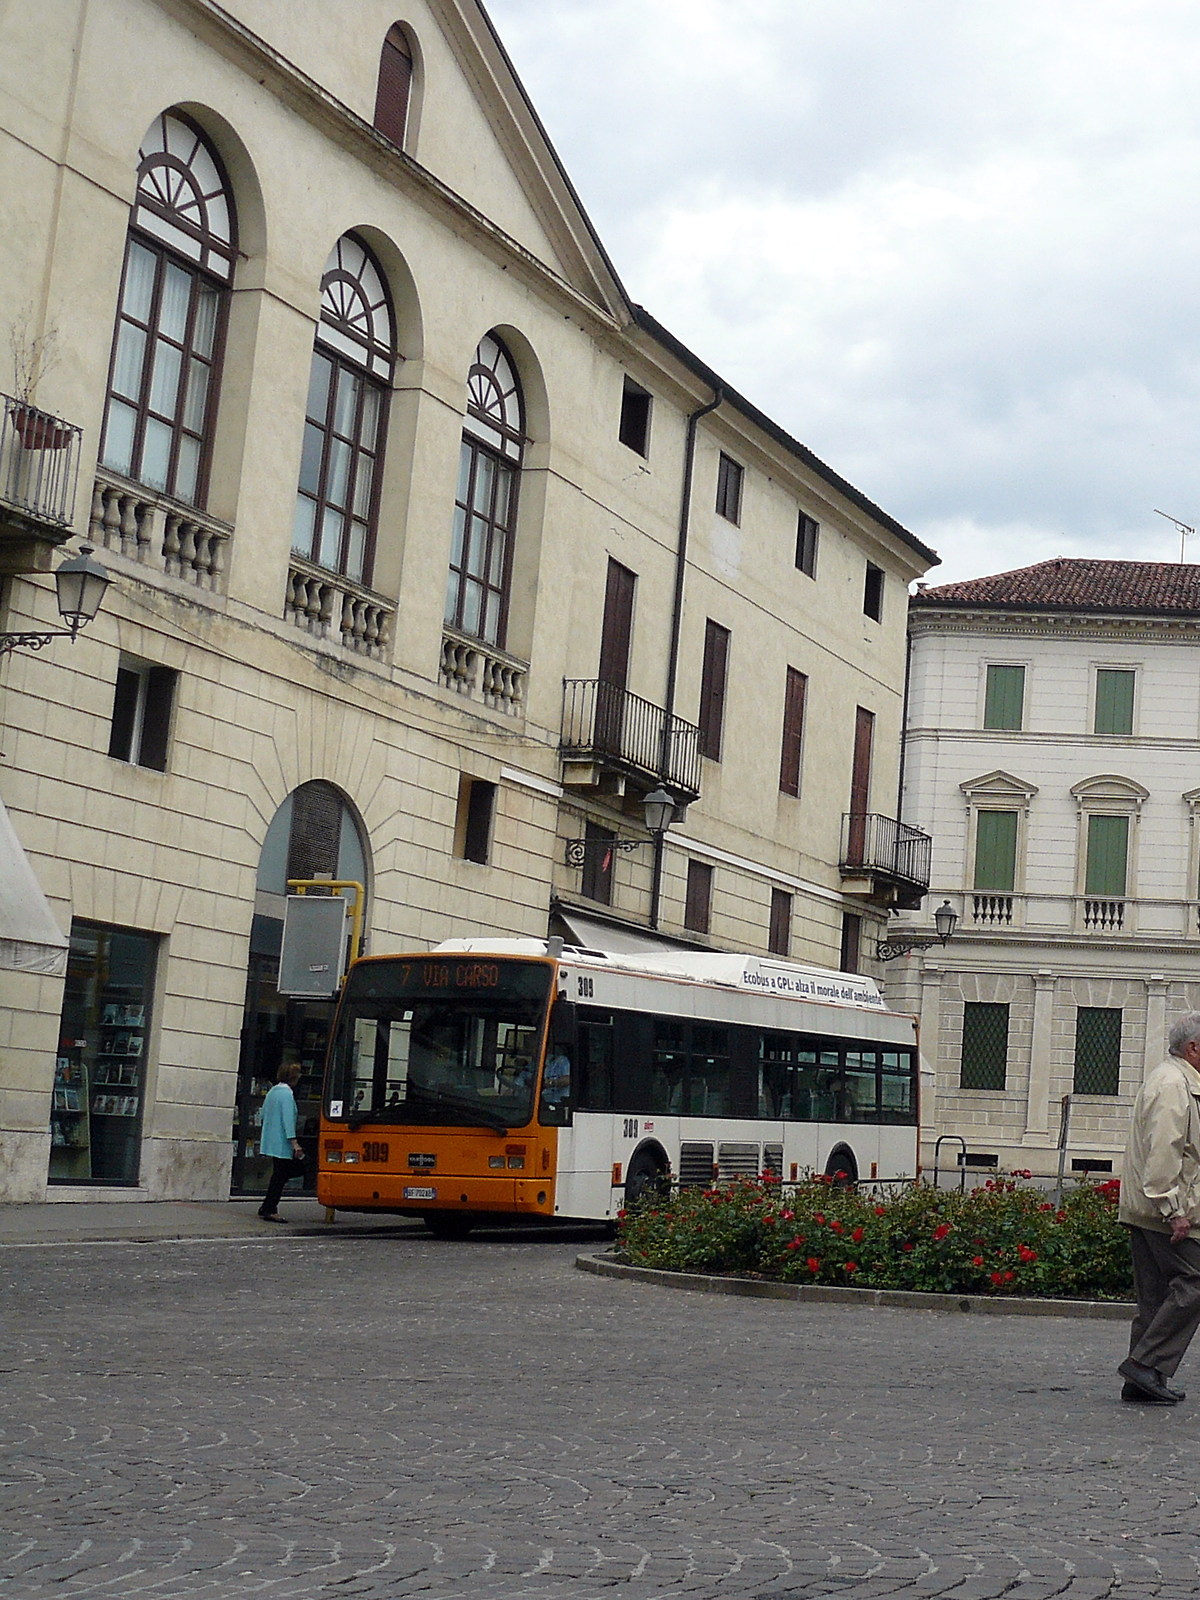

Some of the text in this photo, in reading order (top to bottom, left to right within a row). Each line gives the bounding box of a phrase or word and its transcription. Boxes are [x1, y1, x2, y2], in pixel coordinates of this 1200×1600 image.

[402, 964, 499, 987] 7 VIA CARSO
[743, 970, 770, 987] Ecobus
[771, 977, 776, 988] a
[777, 976, 794, 991] GPL:
[795, 979, 810, 993] alza
[810, 980, 816, 995] il
[816, 984, 840, 999] morale
[578, 976, 593, 998] 309
[624, 1118, 638, 1138] 309
[362, 1141, 389, 1162] 309
